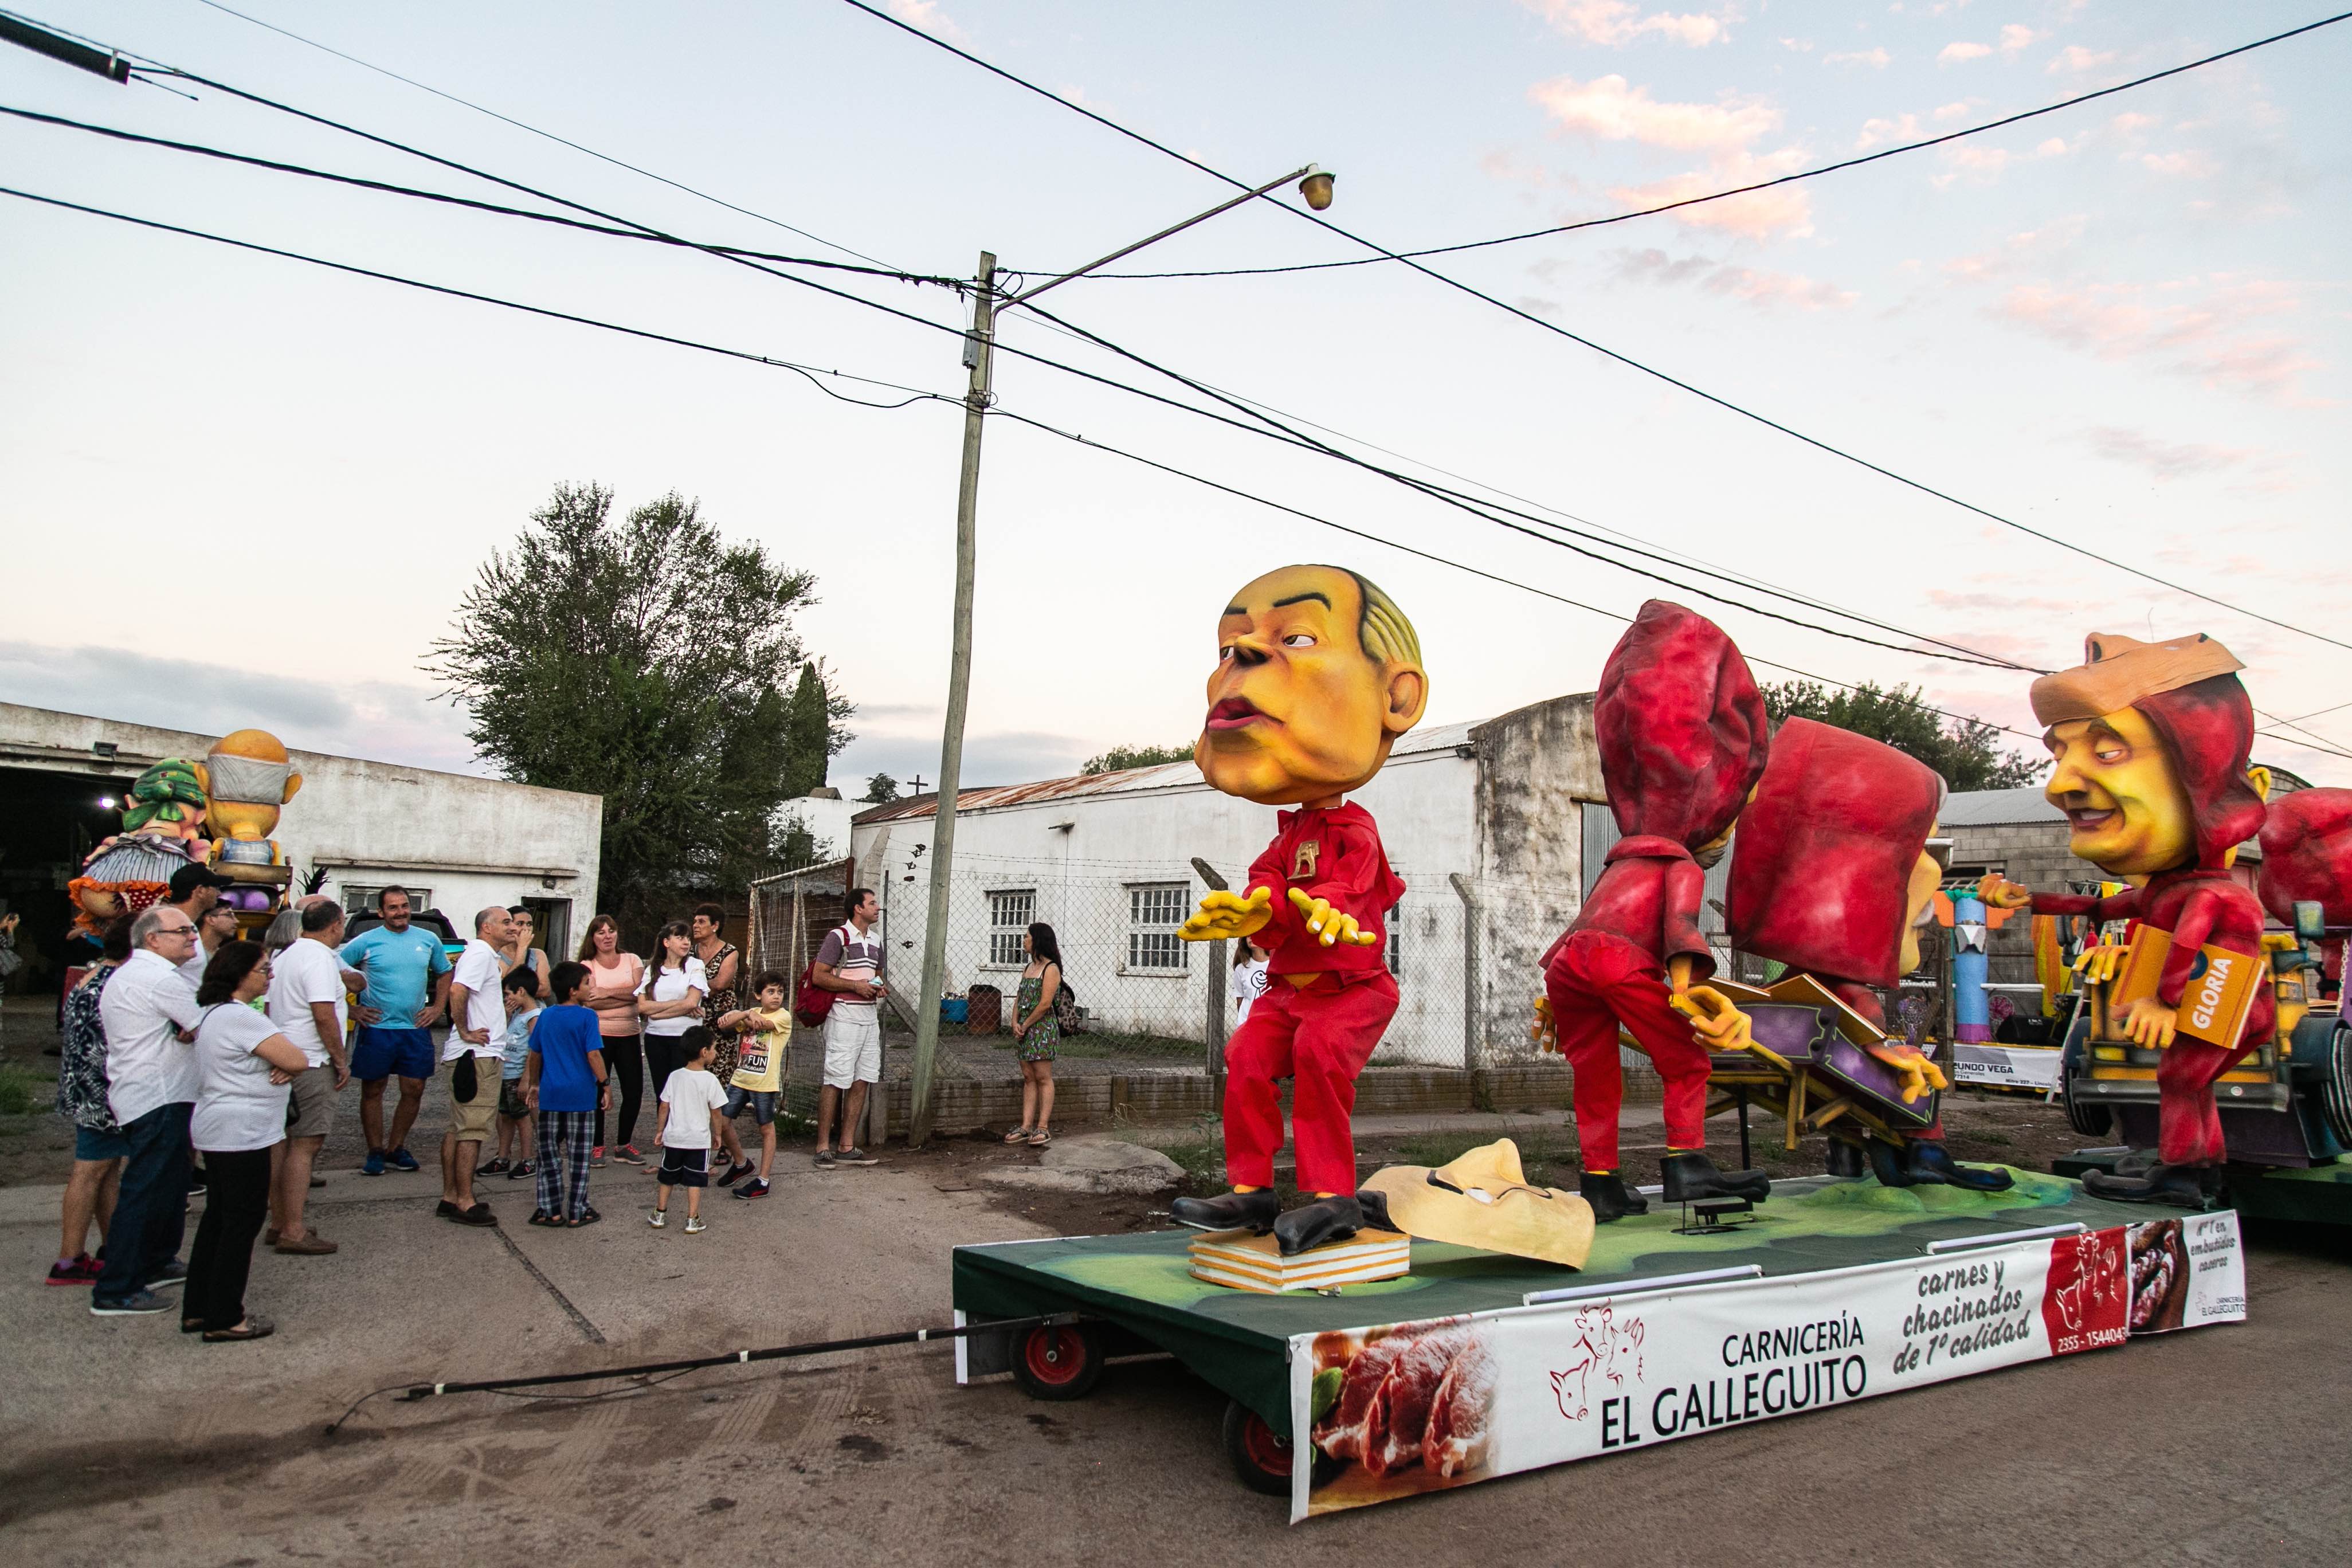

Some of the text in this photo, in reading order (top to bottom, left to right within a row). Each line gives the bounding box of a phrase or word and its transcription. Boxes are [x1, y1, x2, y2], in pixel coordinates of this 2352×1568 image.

[2192, 958, 2232, 1029] GLORIA
[748, 1055, 767, 1067] FUN
[1988, 1065, 2014, 1073] VEGA
[2190, 1235, 2235, 1256] embutidos
[2199, 1256, 2228, 1272] caseros
[1918, 1260, 2004, 1297] carnes y
[1903, 1285, 2022, 1337] chacinados
[1722, 1310, 1865, 1367] CARNICERÍA
[1893, 1342, 1920, 1374] de
[1950, 1310, 2030, 1358] calidad
[2057, 1335, 2079, 1353] 2355
[1602, 1354, 1867, 1449] EL GALLEGUITO
